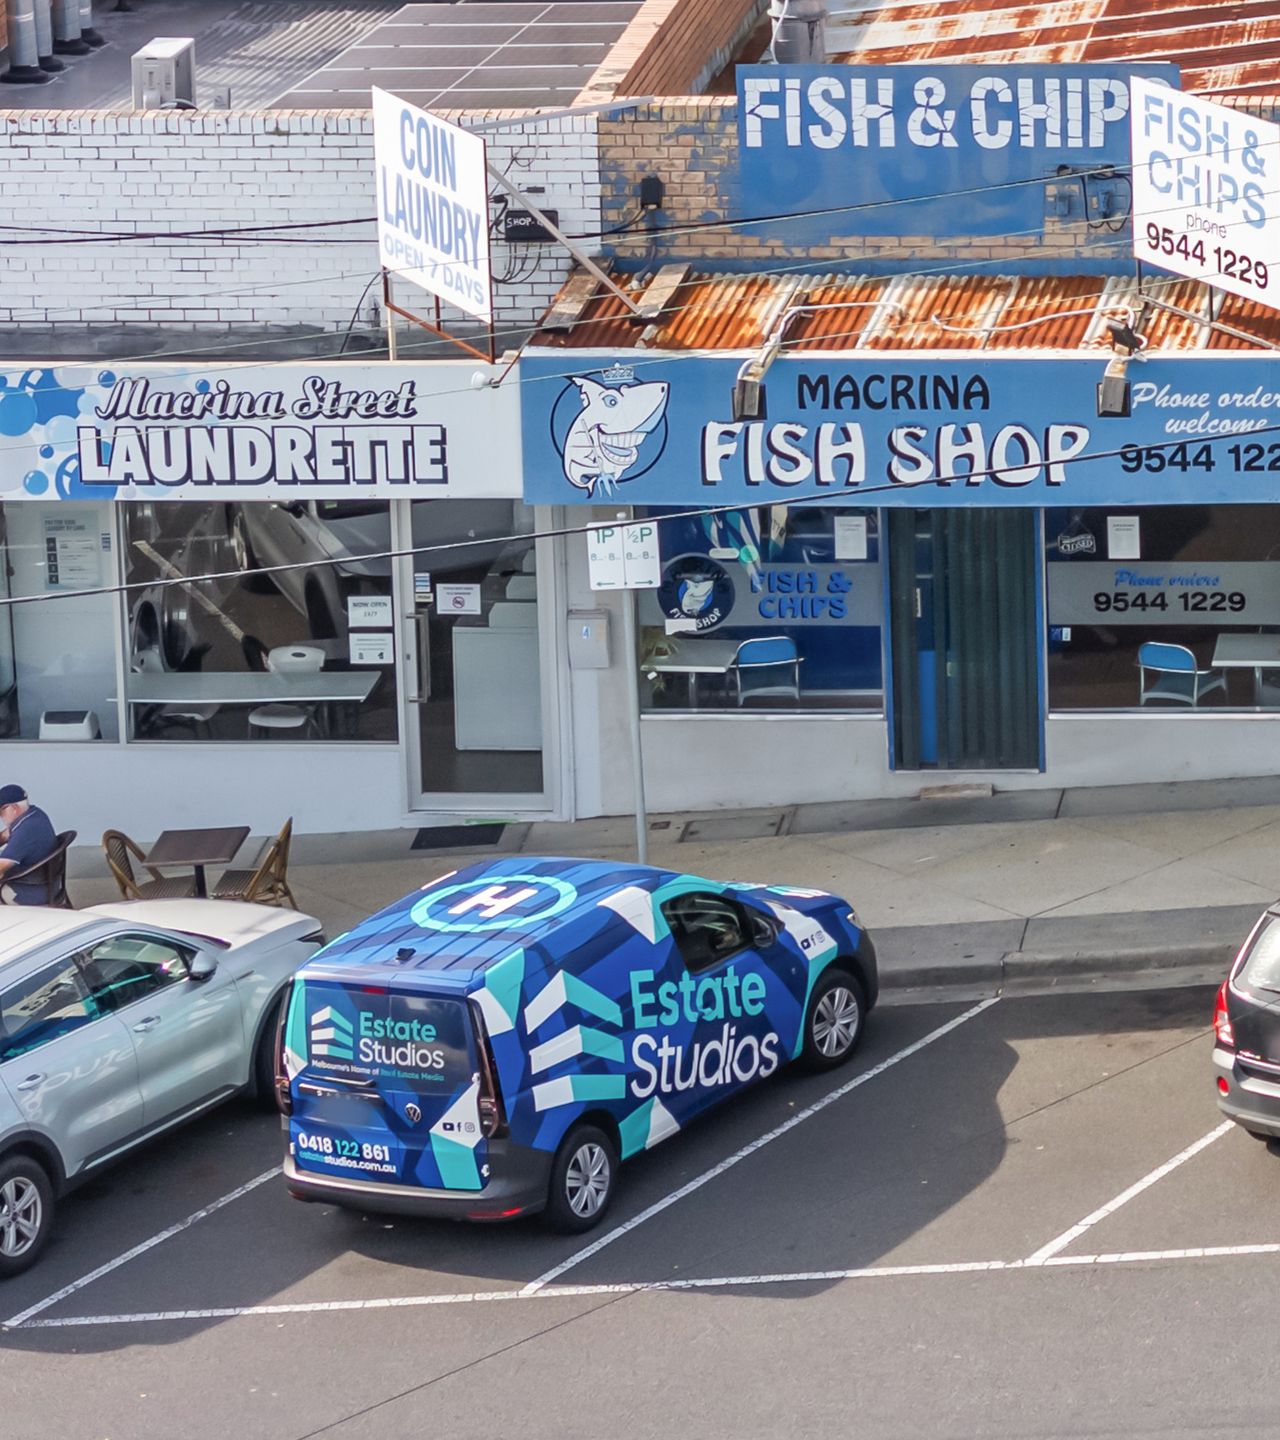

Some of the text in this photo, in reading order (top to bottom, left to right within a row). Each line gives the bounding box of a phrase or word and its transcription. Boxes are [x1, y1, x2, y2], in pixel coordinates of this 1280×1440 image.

[743, 76, 1176, 149] FISH & CHIP
[1144, 94, 1266, 176] FISH &
[400, 108, 456, 193] COIN
[1148, 150, 1267, 230] CHIPS
[383, 165, 481, 270] LAUNDRY
[1186, 210, 1228, 240] phone
[384, 238, 485, 306] OPEN 7 DAYS
[1146, 222, 1269, 291] 9544 1229
[95, 375, 418, 421] Macrina Street
[797, 373, 990, 410] MACRINA
[1132, 381, 1210, 410] Phone
[1165, 415, 1268, 434] welcome
[78, 425, 448, 485] LAUNDRETTE
[700, 421, 1090, 488] FISH SHOP
[1119, 444, 1216, 473] 9544
[750, 570, 819, 594] FISH
[826, 570, 853, 594] &
[1093, 592, 1246, 612] 9544 1229
[758, 595, 850, 619] CHIPS
[630, 966, 767, 1029] Estate
[359, 1011, 437, 1043] Estate
[359, 1037, 446, 1069] Studios
[630, 1025, 779, 1098] Studios
[298, 1133, 390, 1161] 0418 122 861
